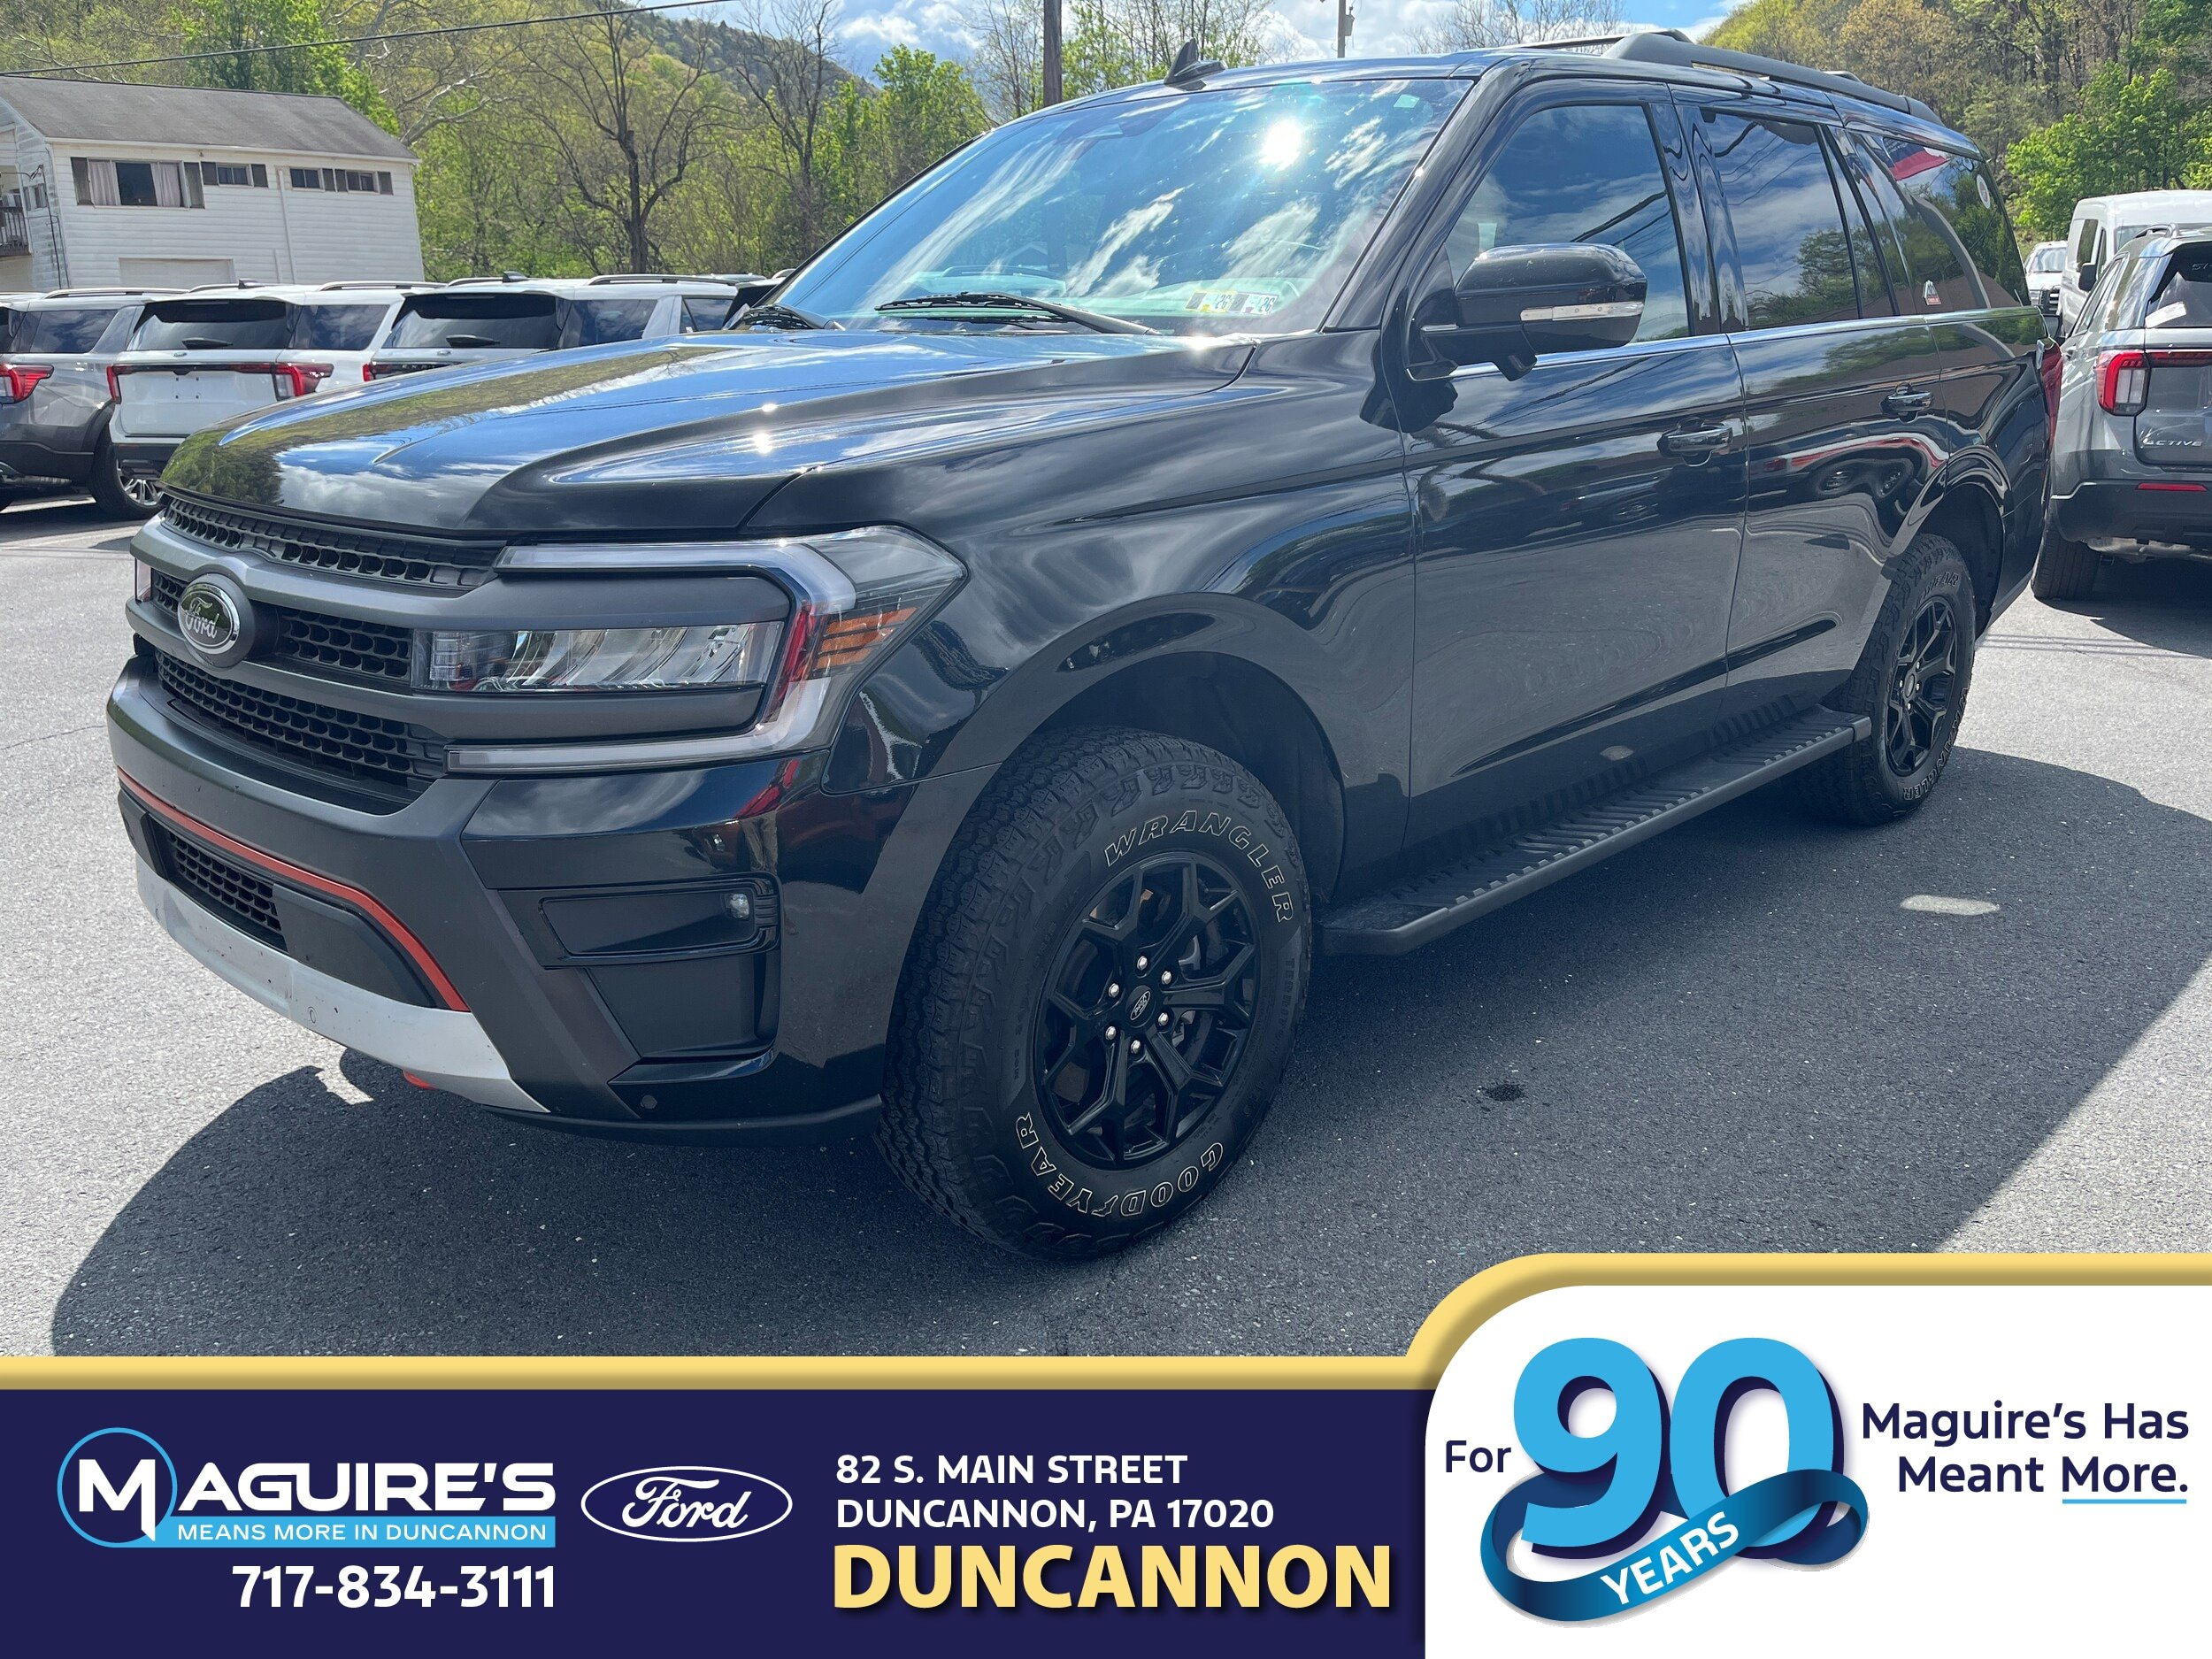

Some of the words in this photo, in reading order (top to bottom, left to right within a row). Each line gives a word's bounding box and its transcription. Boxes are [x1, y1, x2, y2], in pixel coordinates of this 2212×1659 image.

[184, 596, 221, 639] Ford
[1104, 810, 1294, 923] WRANGLER
[1015, 1111, 1224, 1217] GOODYEAR
